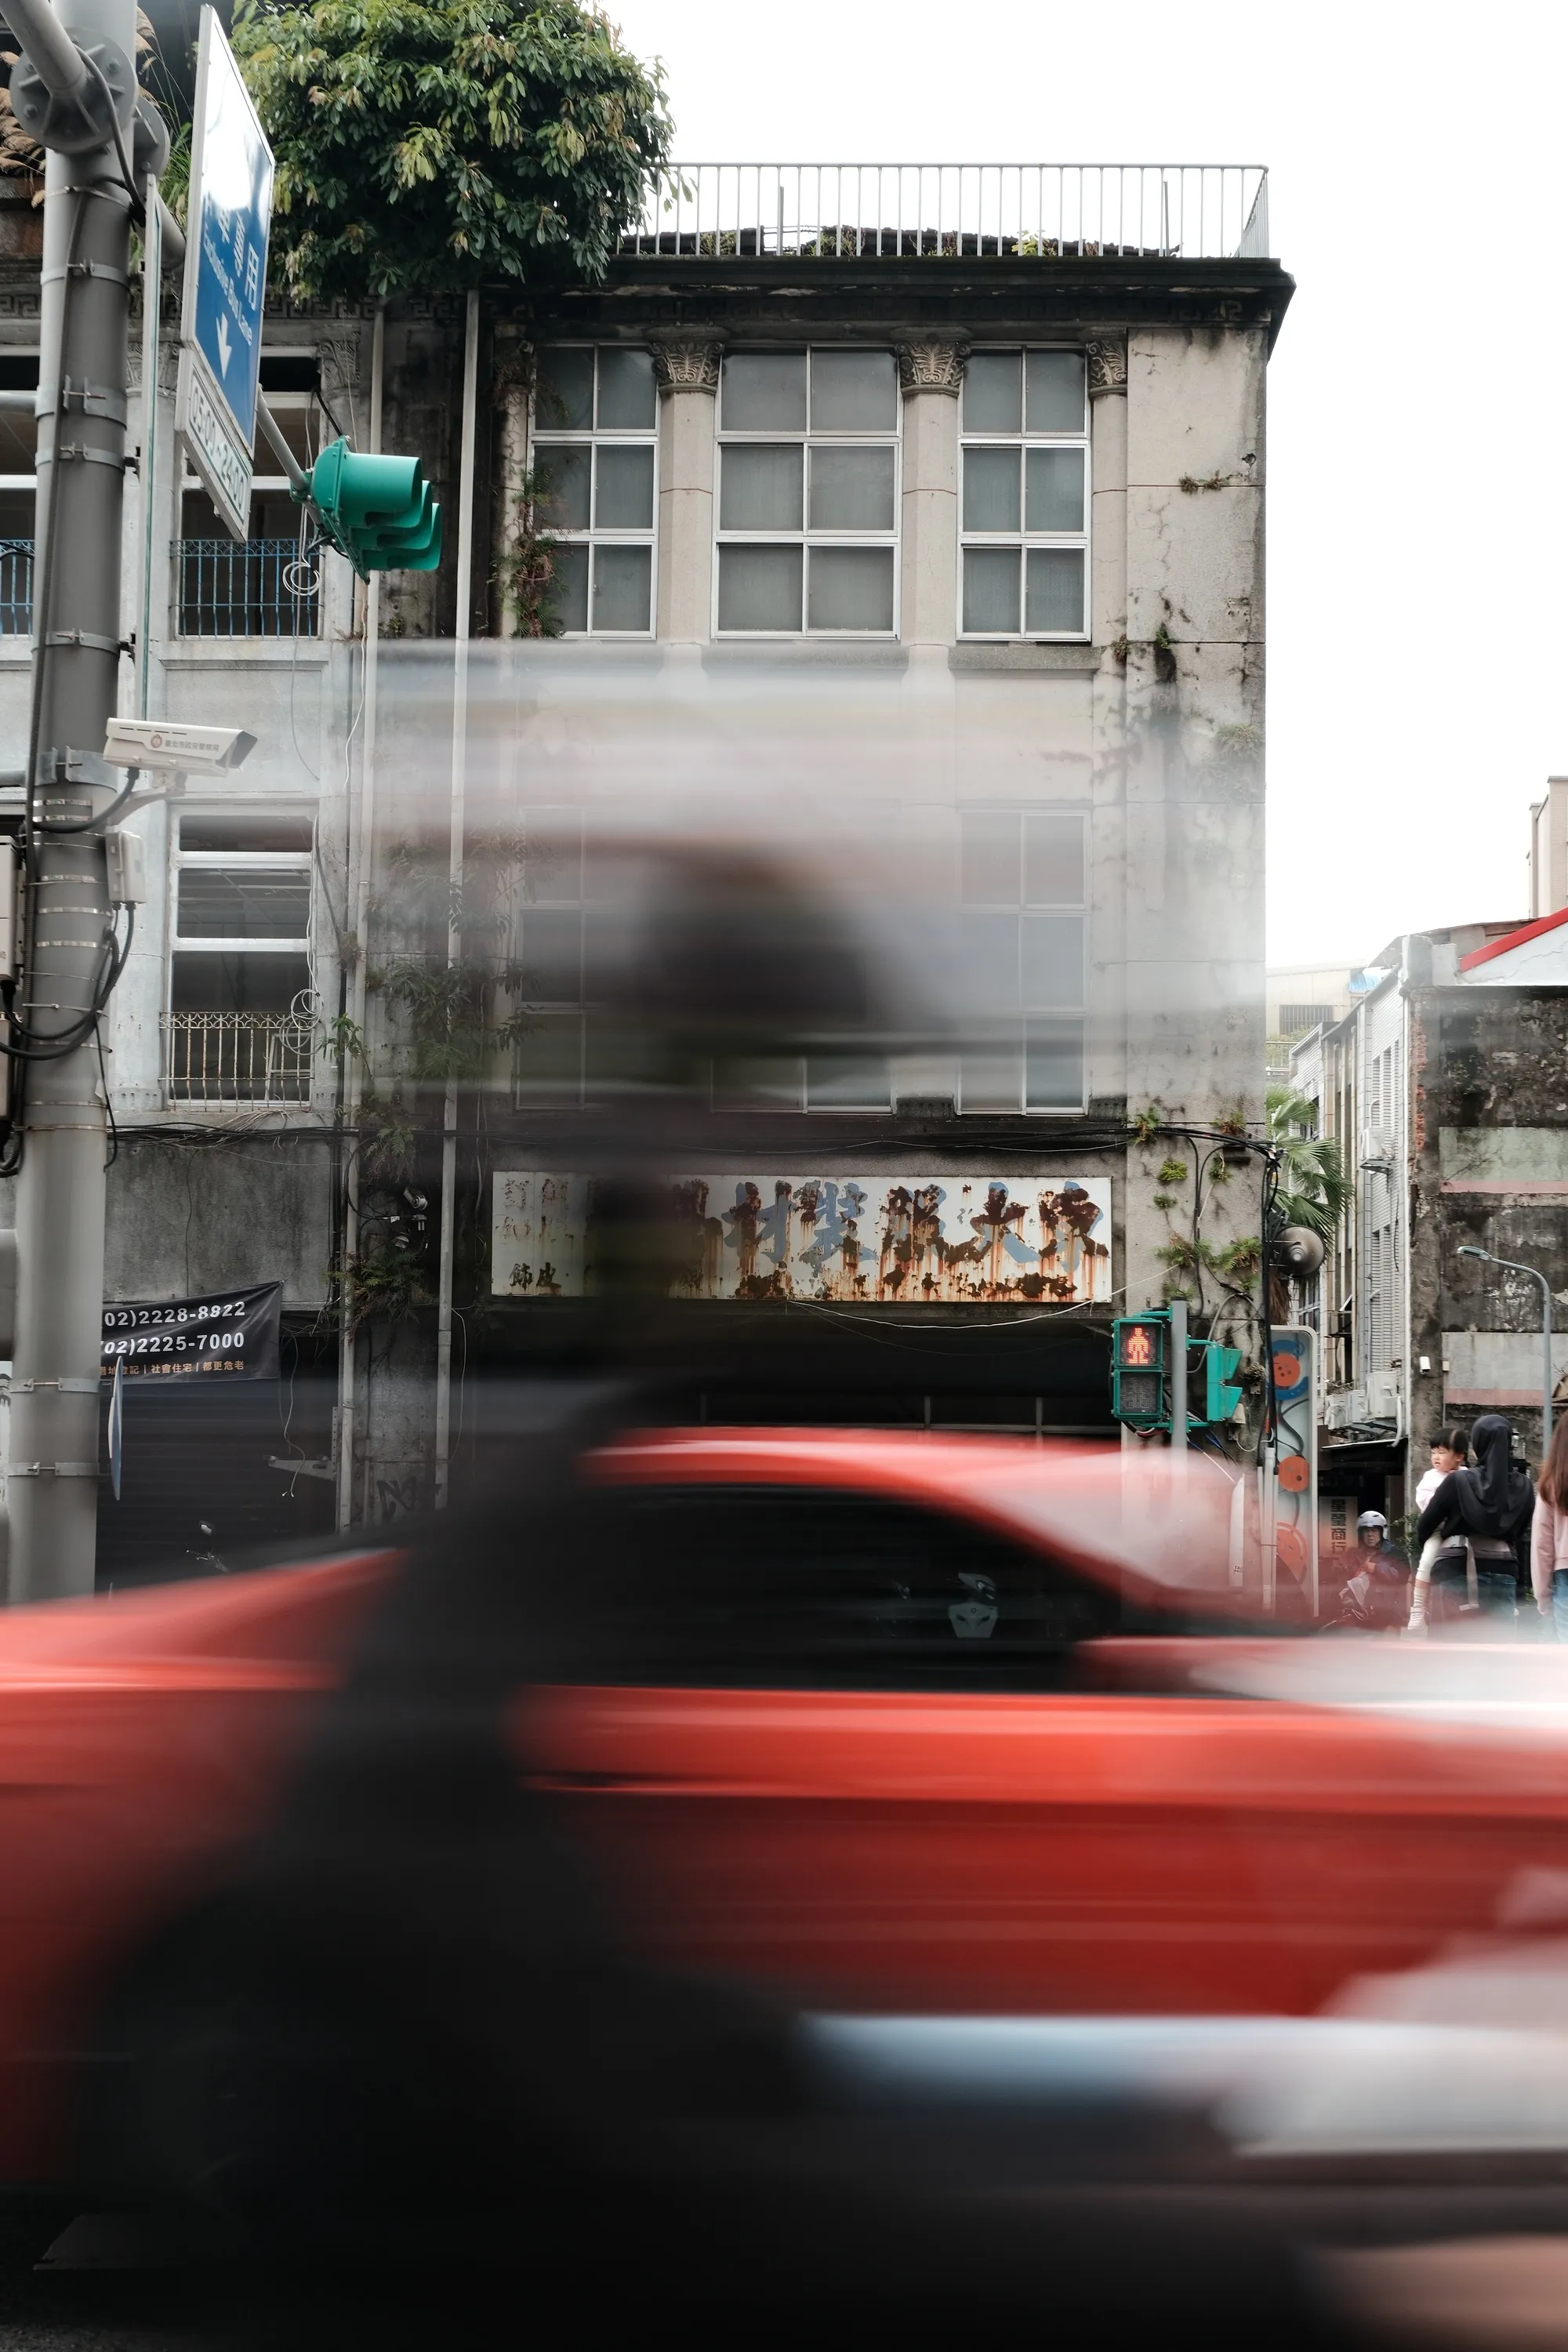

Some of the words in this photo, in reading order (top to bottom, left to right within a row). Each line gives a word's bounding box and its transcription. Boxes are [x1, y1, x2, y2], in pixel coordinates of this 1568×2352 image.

[102, 1301, 245, 1327] 02)2228-8822
[151, 1362, 192, 1375] 社會住宅
[202, 1360, 245, 1371] 都更危老
